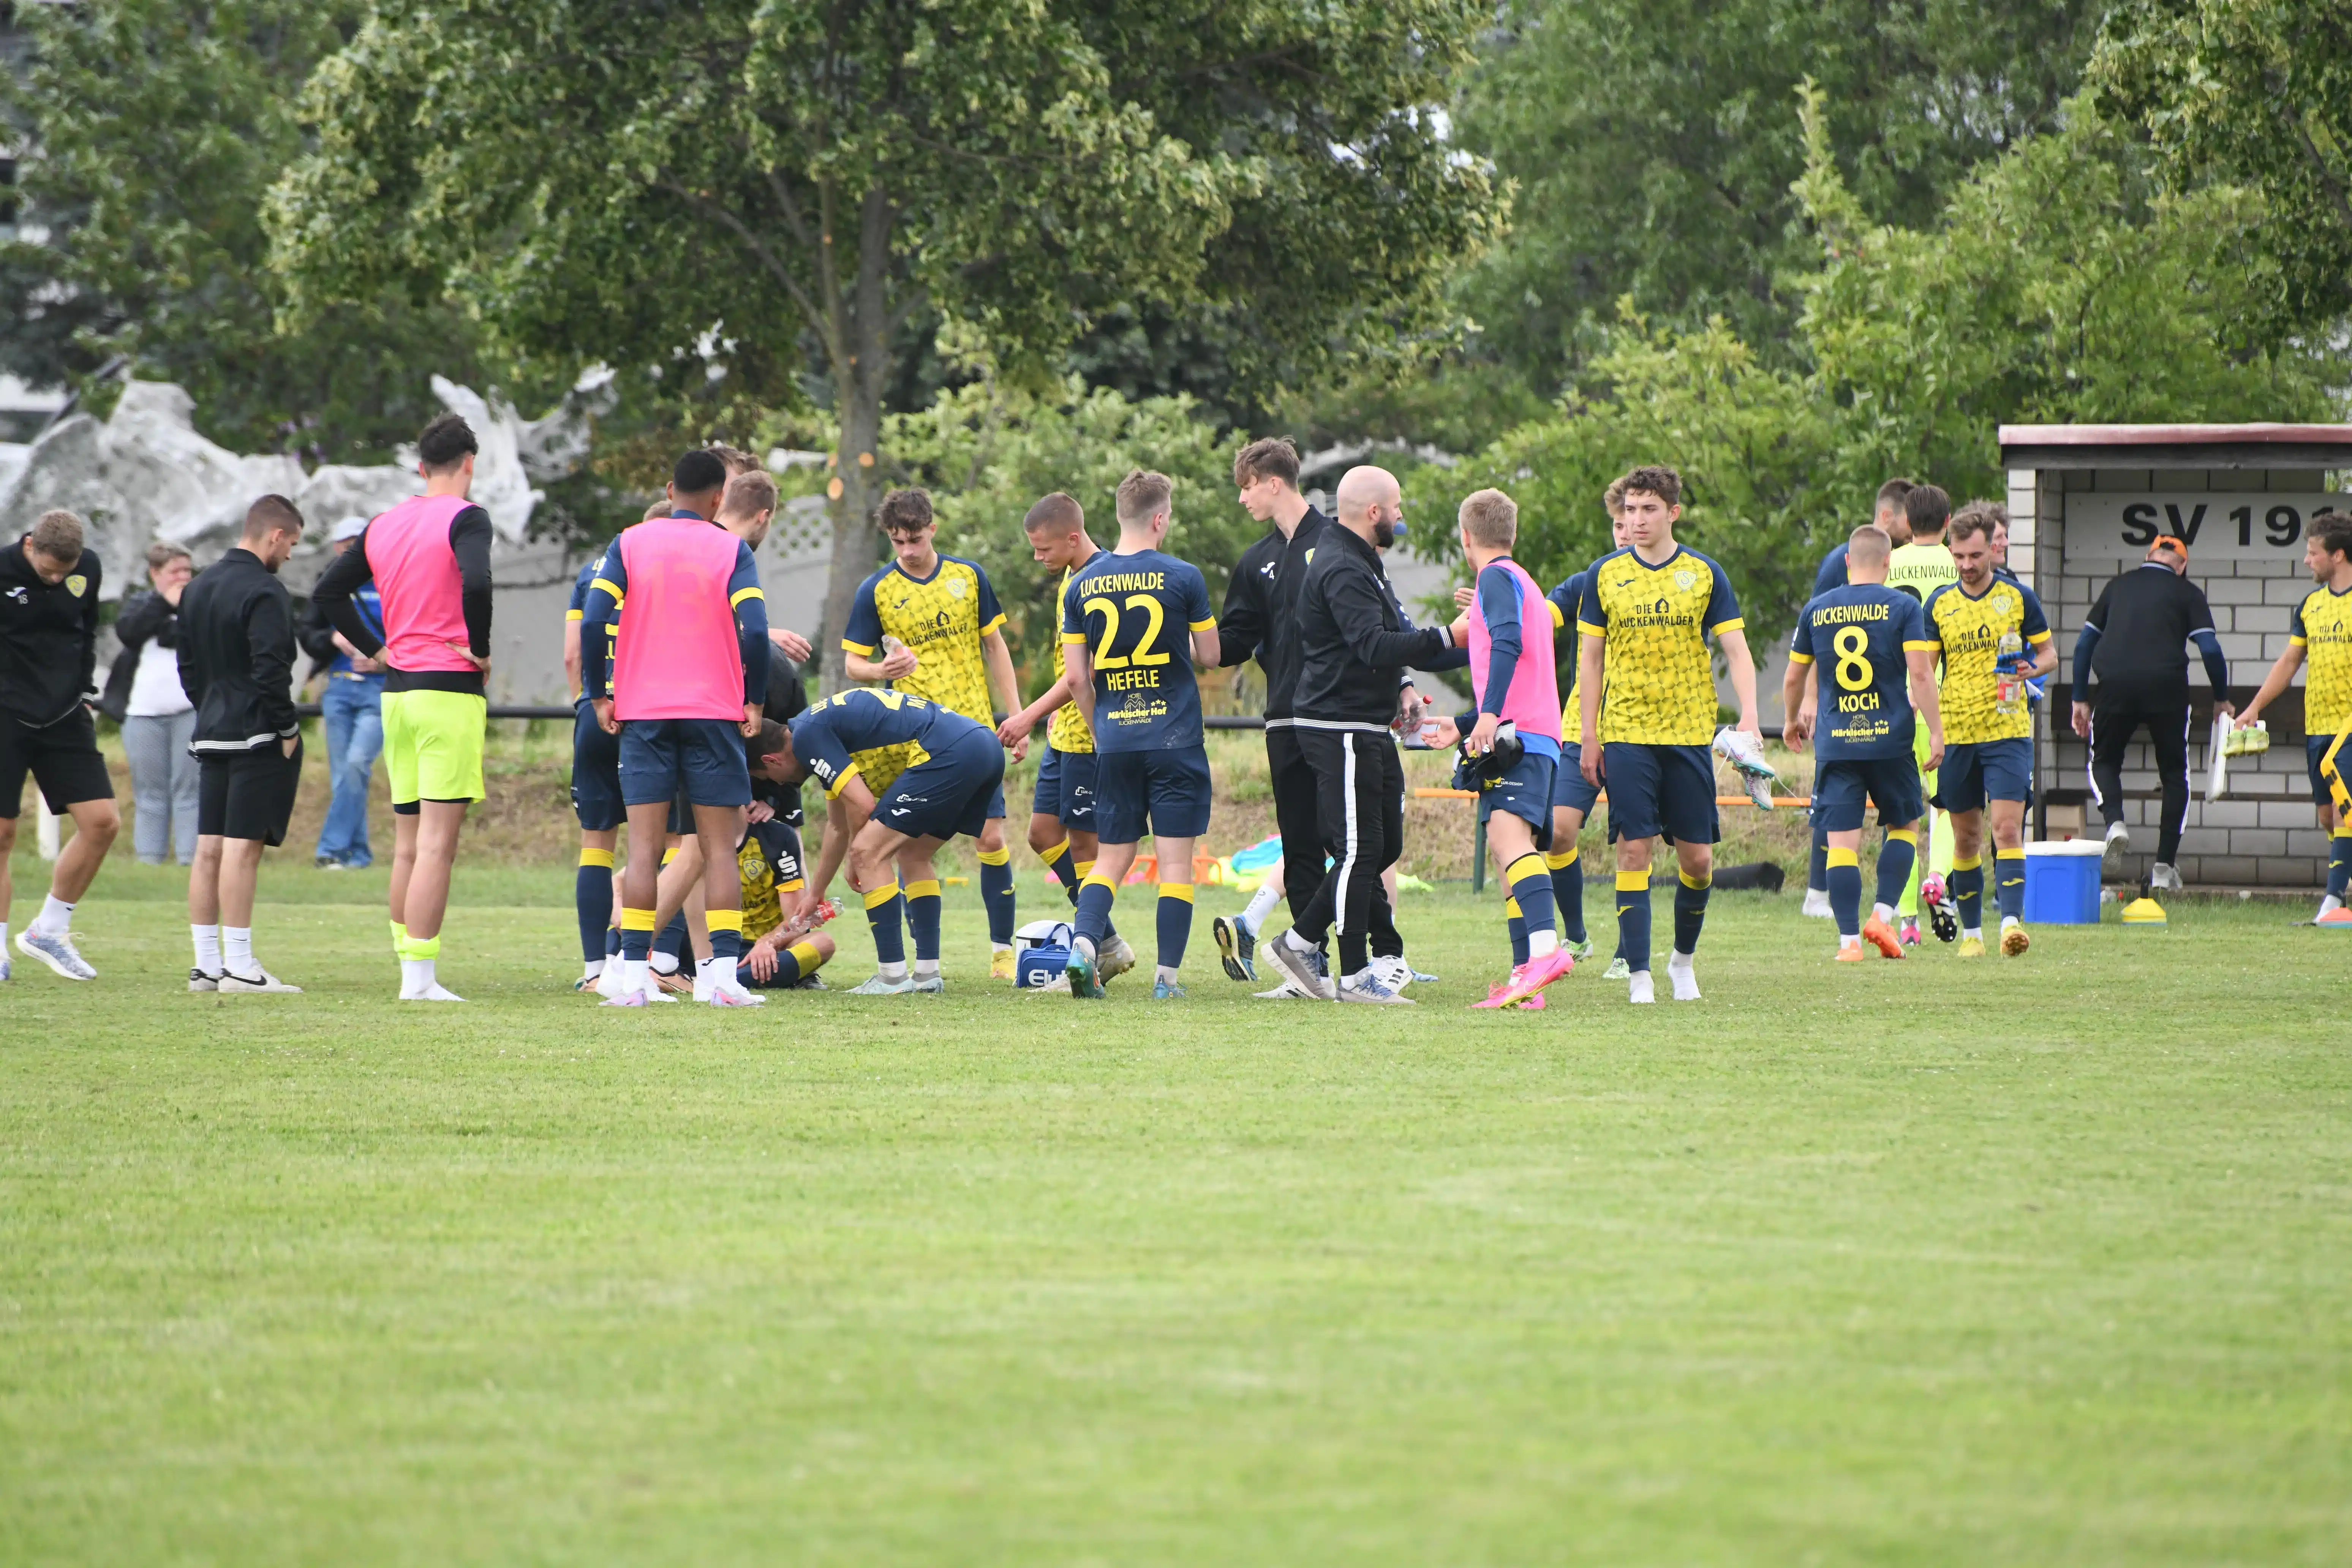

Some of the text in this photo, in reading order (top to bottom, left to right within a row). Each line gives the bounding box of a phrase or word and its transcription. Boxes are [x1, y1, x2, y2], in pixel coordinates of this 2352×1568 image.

[2121, 502, 2208, 547] SV
[1269, 569, 1275, 580] 4
[1889, 565, 1960, 580] LUCKENWALD
[1080, 572, 1164, 598] LUCKENWALDE
[18, 594, 28, 605] 18
[1636, 604, 1652, 614] DIE
[1813, 604, 1889, 627] LUCKENWALDE
[920, 619, 936, 631] DIE
[1619, 615, 1693, 628] LUCKENWALDER
[1083, 594, 1170, 670] 22
[1962, 630, 1974, 641] DIE
[1834, 625, 1873, 691] 8
[1106, 669, 1160, 691] HEFELE
[1839, 692, 1879, 713] KOCH
[1107, 707, 1167, 720] Märkischer Hof
[1875, 726, 1889, 735] Hof
